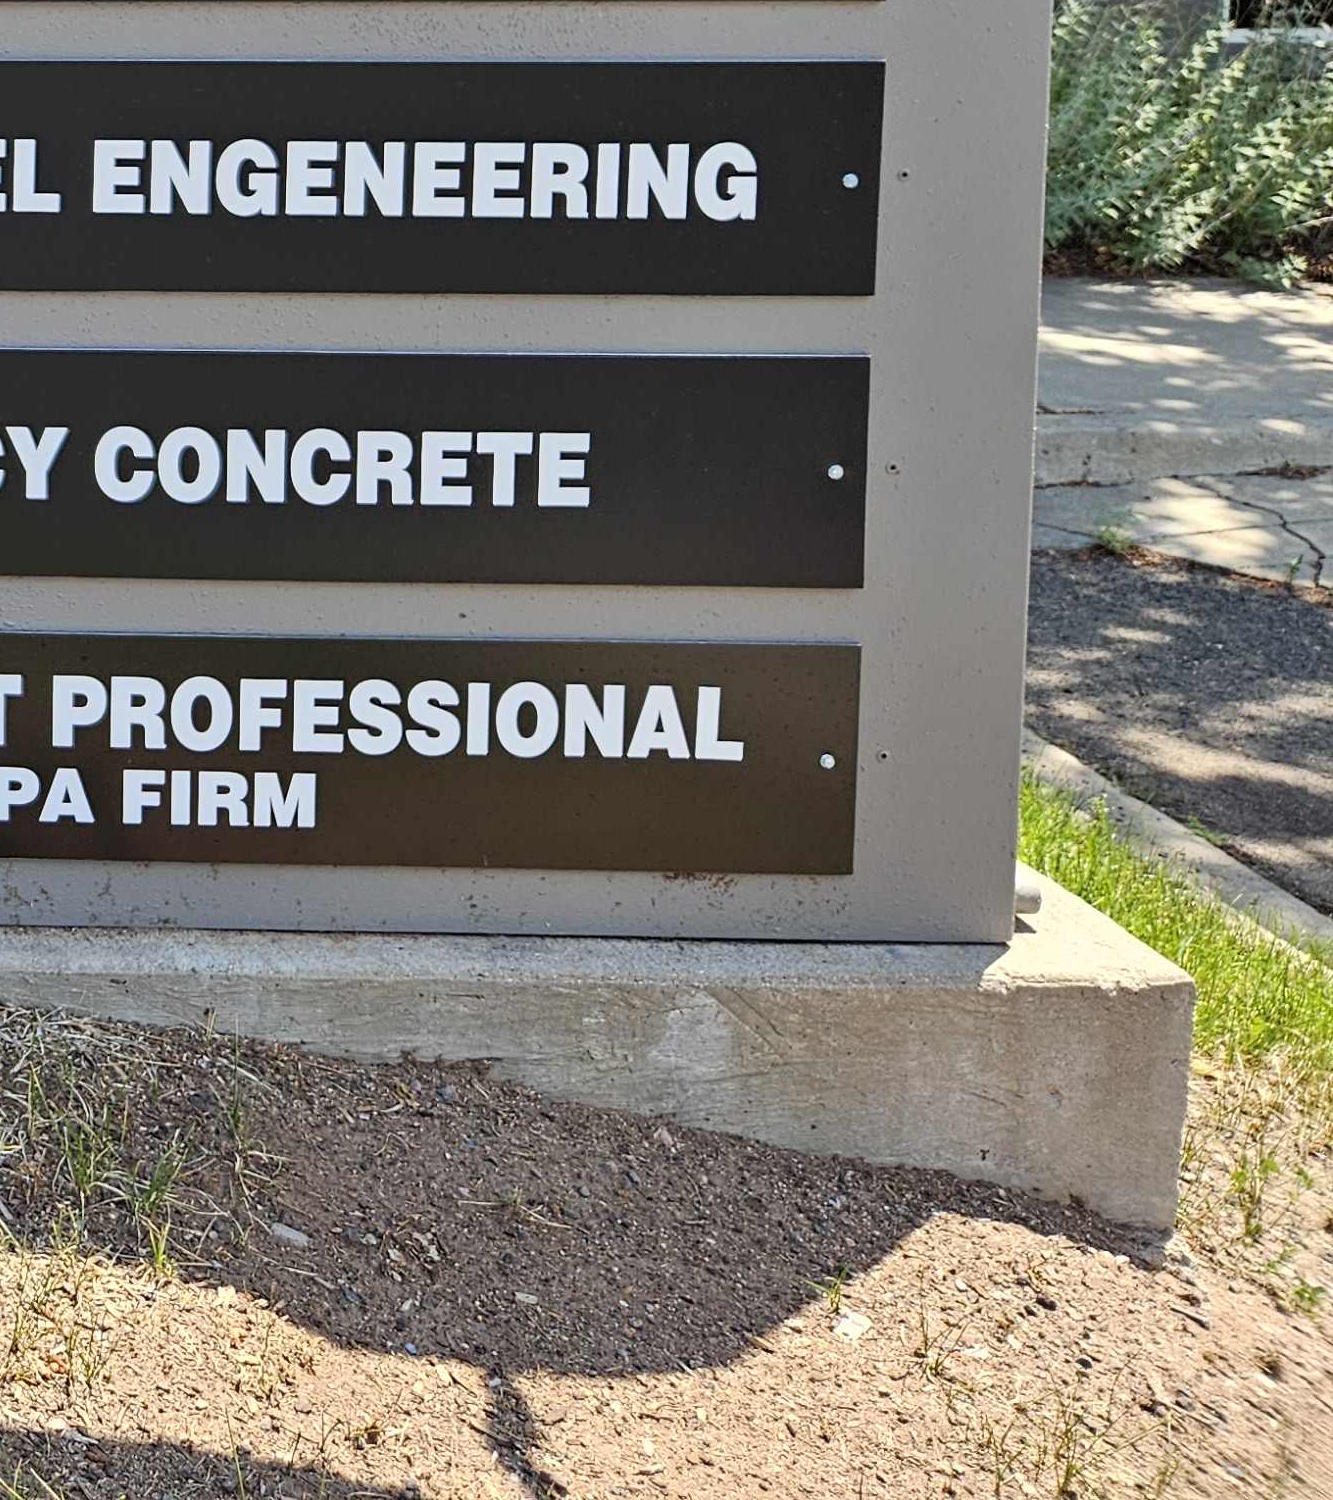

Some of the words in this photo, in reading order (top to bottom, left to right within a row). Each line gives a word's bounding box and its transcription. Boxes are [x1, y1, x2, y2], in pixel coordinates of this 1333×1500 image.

[93, 139, 757, 221] ENGENEERING
[95, 426, 590, 507] CONCRETE
[53, 675, 744, 761] PROFESSIONAL
[123, 770, 316, 828] FIRM
